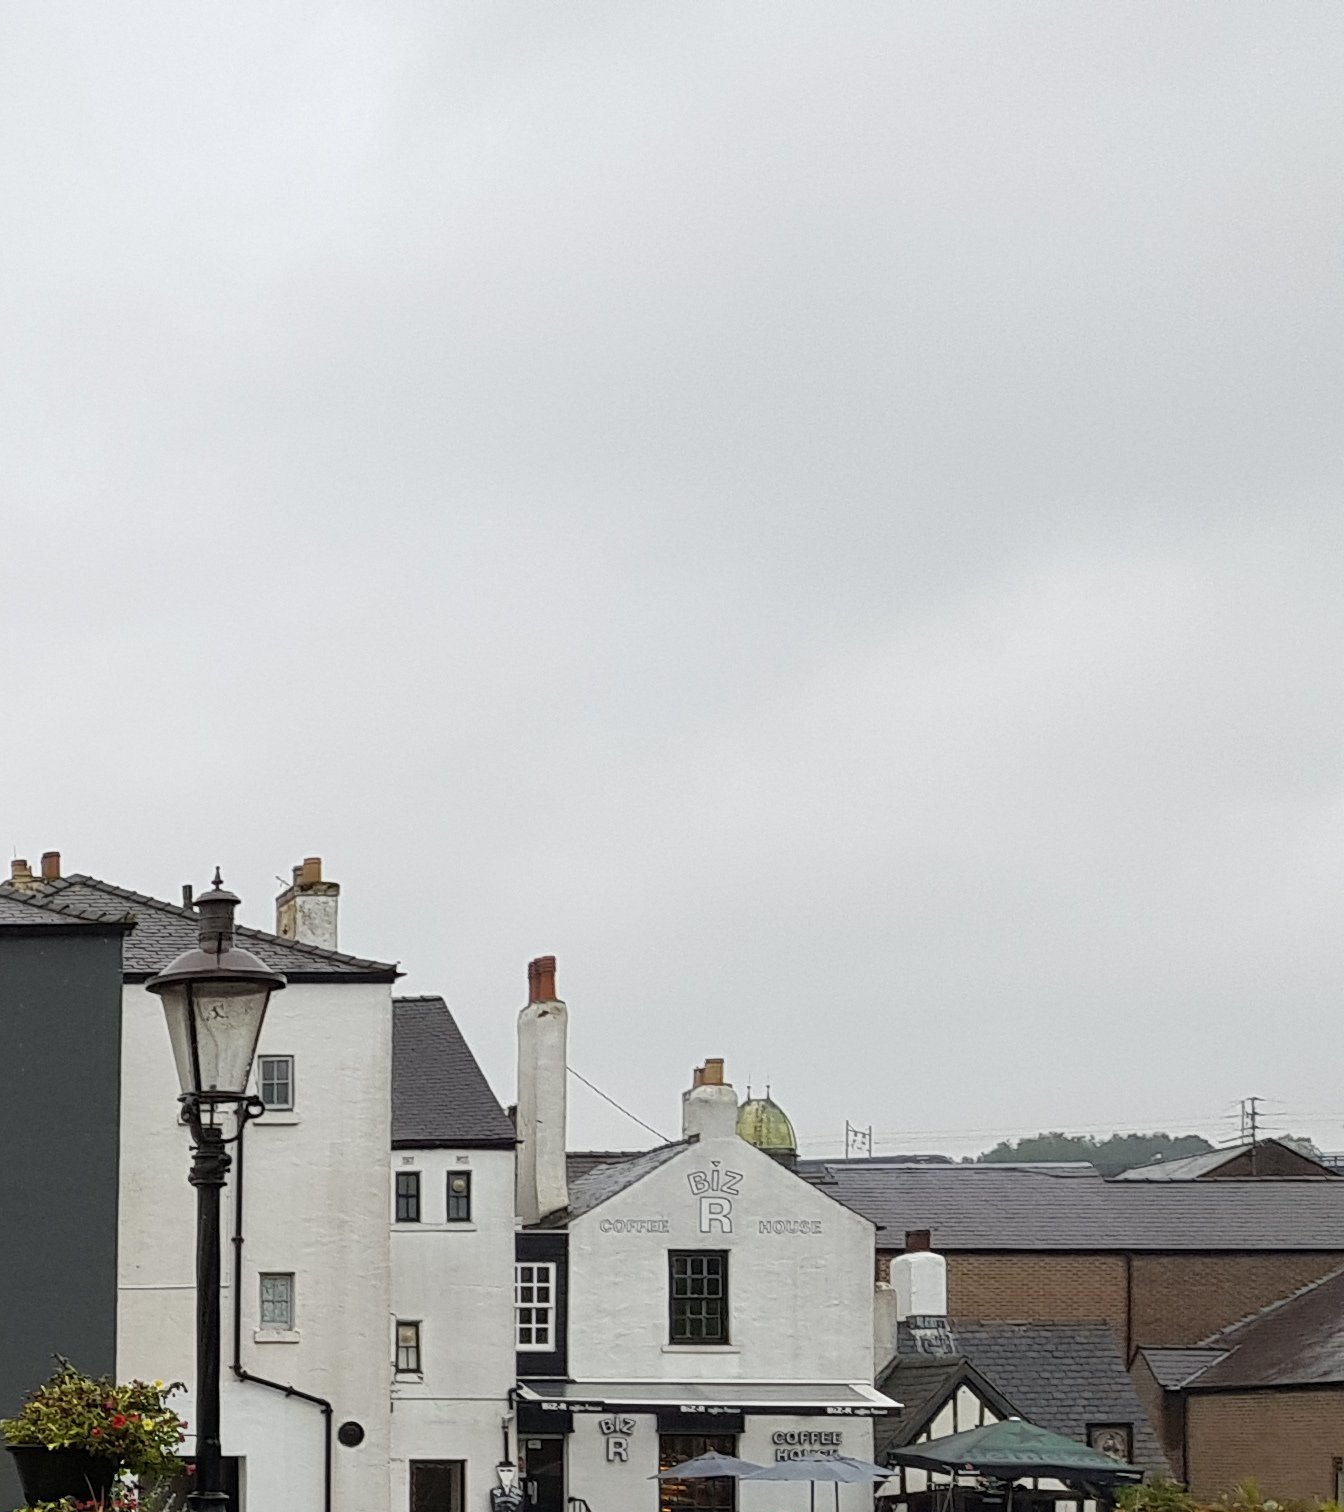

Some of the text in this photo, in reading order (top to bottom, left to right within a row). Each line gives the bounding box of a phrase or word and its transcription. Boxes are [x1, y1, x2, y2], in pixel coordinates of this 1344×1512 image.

[699, 1196, 733, 1234] R
[599, 1219, 823, 1234] COFFEE HOUSE
[772, 1431, 843, 1445] COFFEE
[606, 1437, 628, 1462] R
